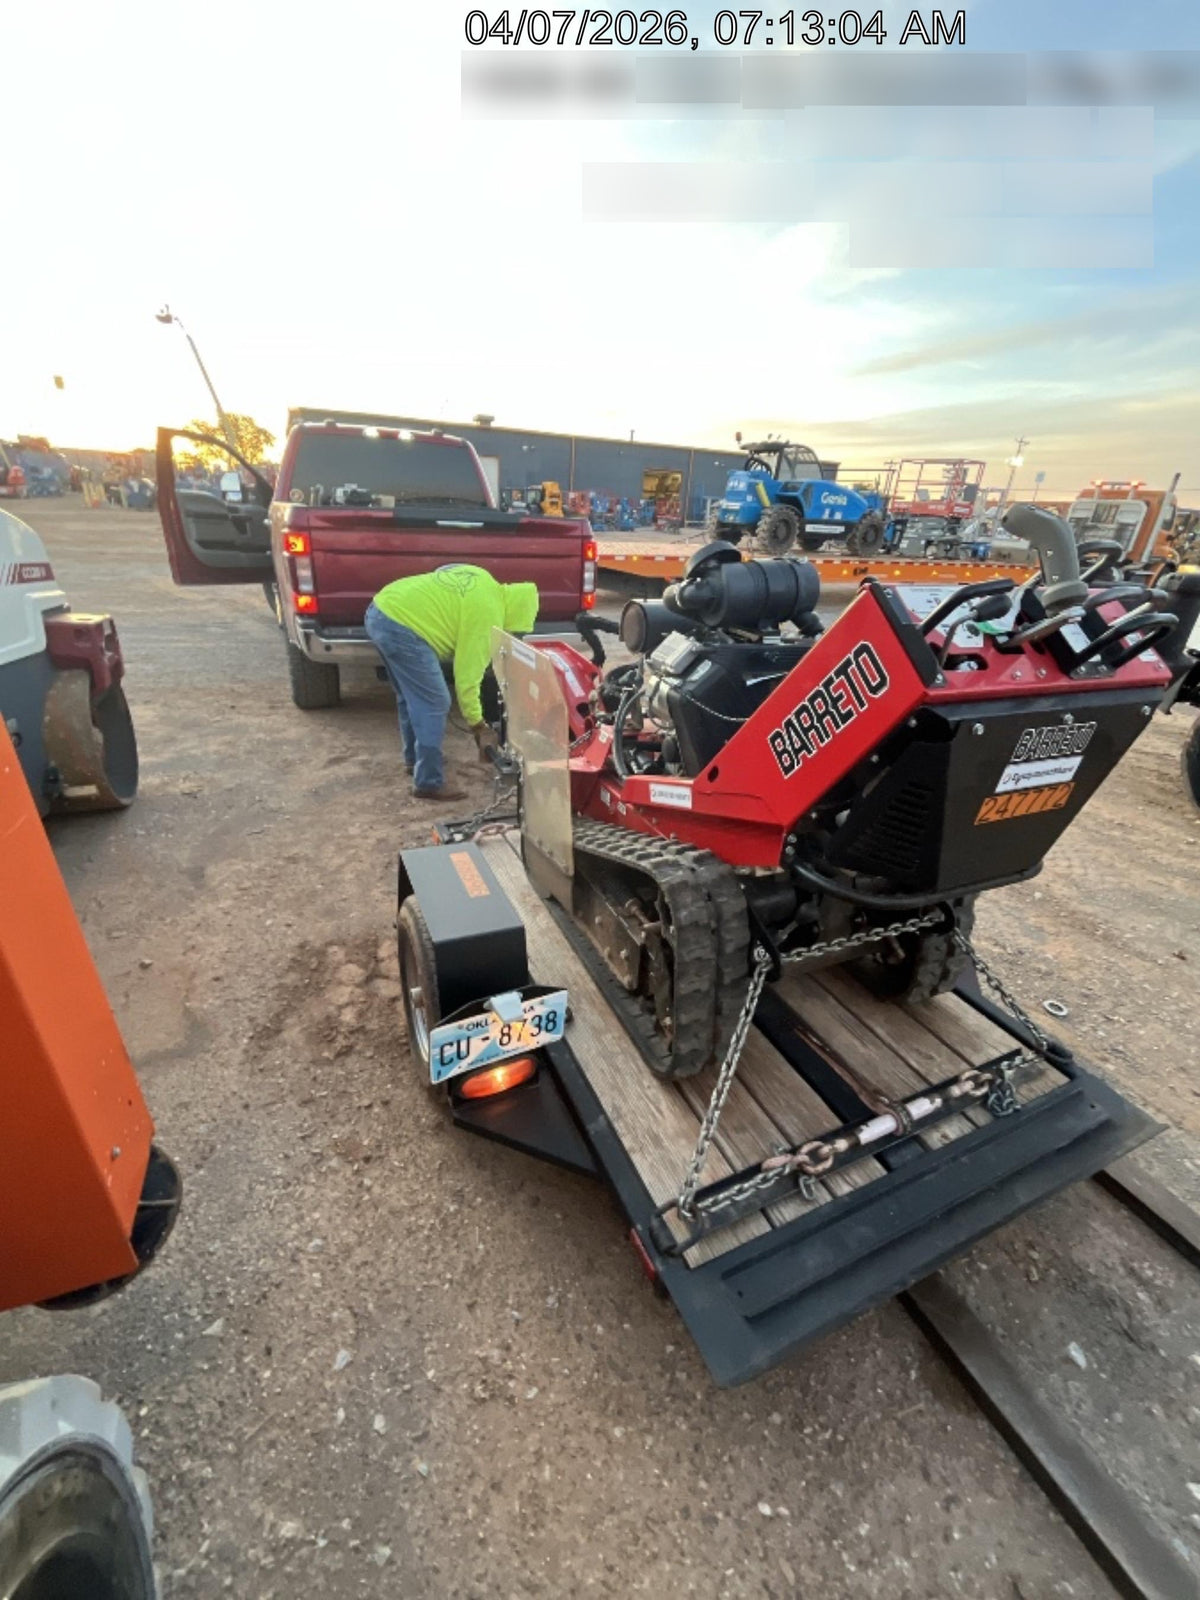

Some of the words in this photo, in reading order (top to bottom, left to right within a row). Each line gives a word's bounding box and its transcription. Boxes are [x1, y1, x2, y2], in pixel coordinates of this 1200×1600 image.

[768, 641, 890, 779] BARRETO
[1010, 721, 1097, 762] BARRETO
[978, 782, 1072, 822] 247772
